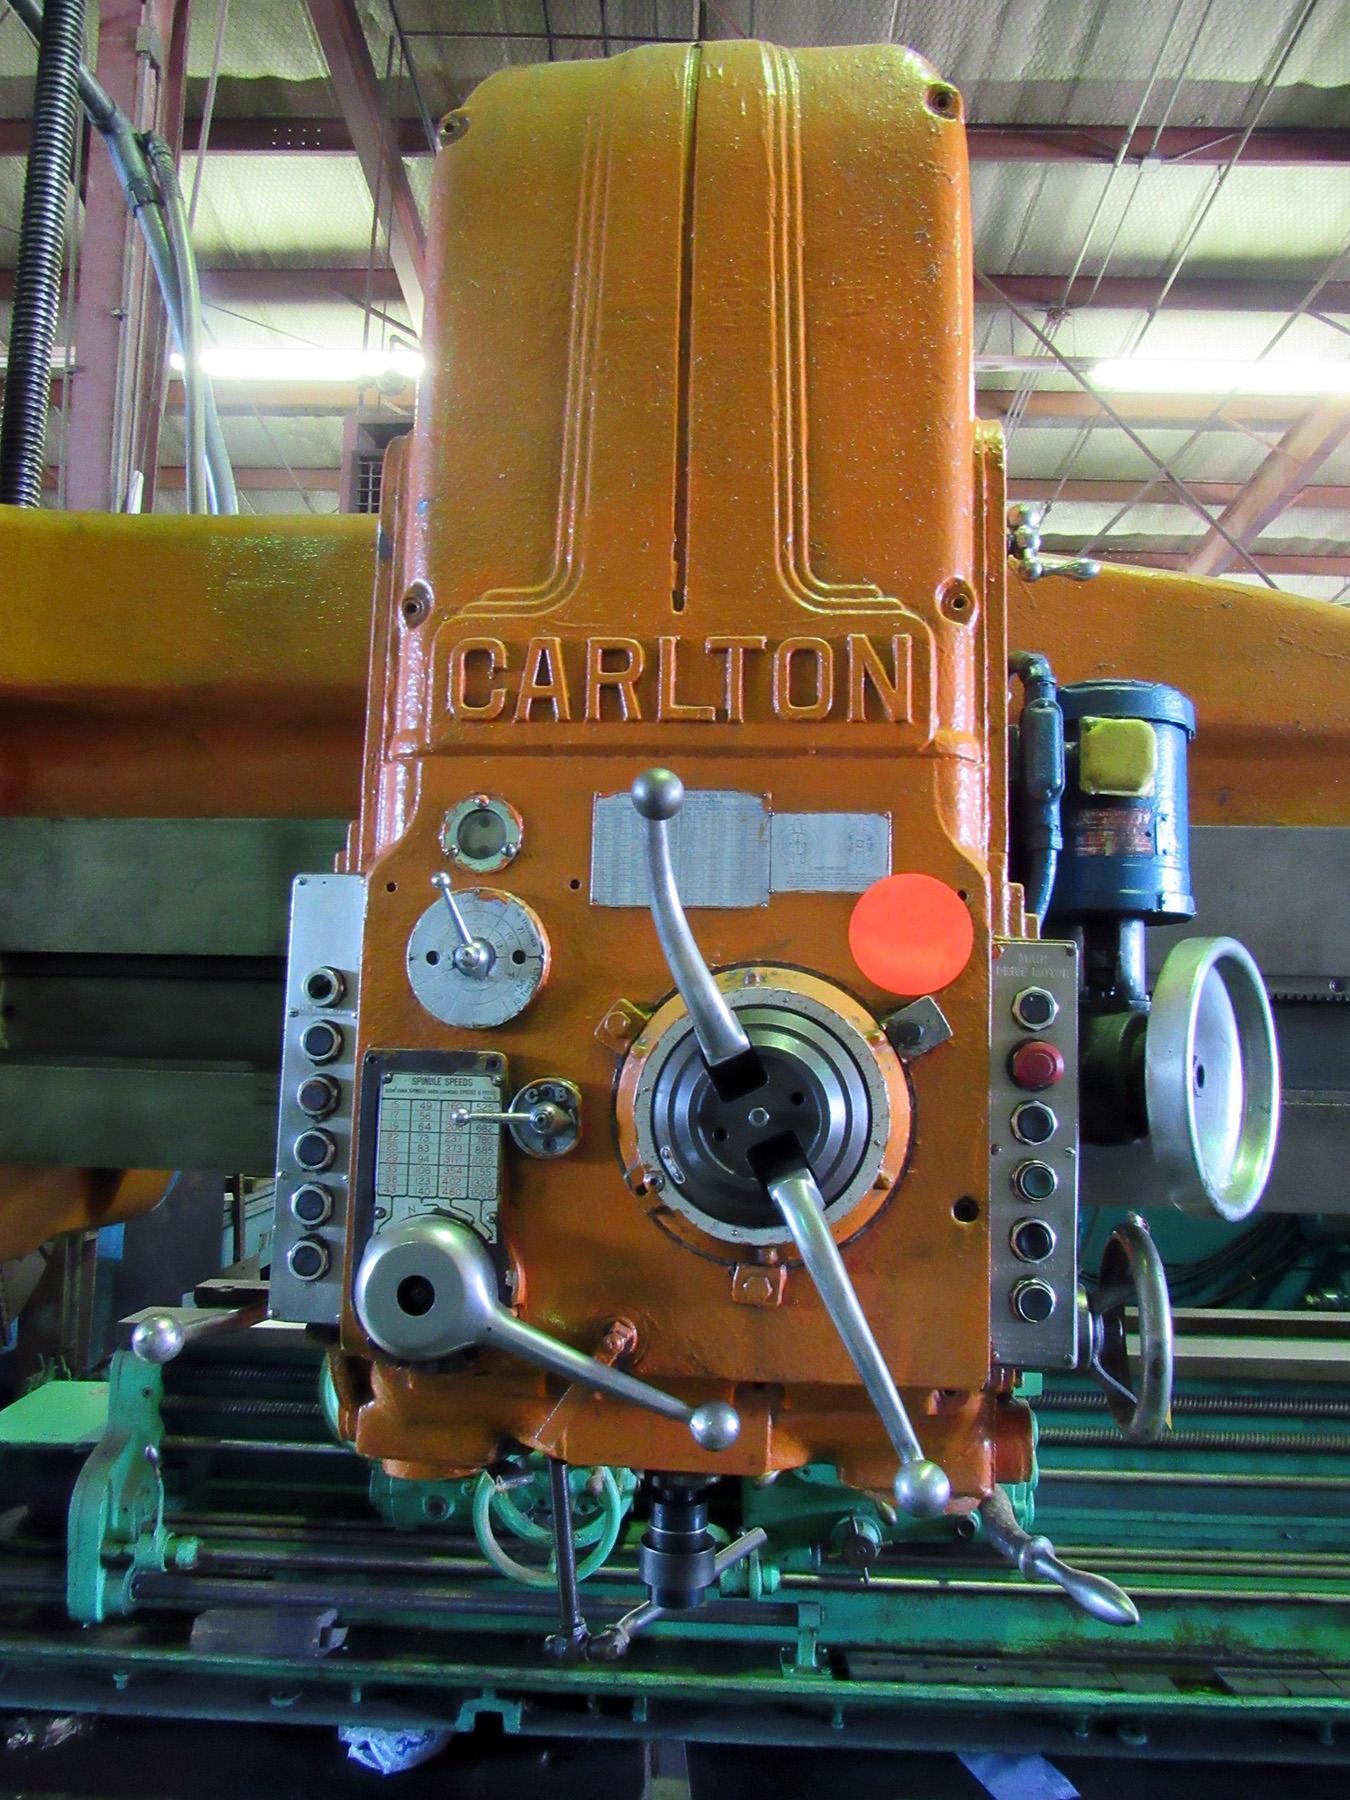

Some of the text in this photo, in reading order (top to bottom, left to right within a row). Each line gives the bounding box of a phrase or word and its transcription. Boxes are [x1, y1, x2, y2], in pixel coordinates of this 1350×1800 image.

[447, 633, 915, 724] CARLTON
[411, 1077, 473, 1087] SPINDLE SPEEDS
[524, 1086, 568, 1103] C B
[419, 1102, 433, 1110] 49
[476, 1103, 493, 1111] 525
[418, 1123, 432, 1131] 64
[418, 1134, 430, 1142] 73
[444, 1135, 463, 1143] 237
[477, 1136, 494, 1144] 780
[386, 1144, 399, 1152] 25
[417, 1144, 430, 1152] 83
[444, 1145, 463, 1153] 273
[417, 1155, 431, 1163] 94
[471, 1157, 494, 1166] 1005
[384, 1165, 398, 1173] 33
[415, 1166, 432, 1174] 108
[443, 1167, 462, 1175] 354
[471, 1168, 491, 1177] 1155
[384, 1175, 398, 1184] 38
[415, 1176, 431, 1185] 123
[442, 1177, 462, 1185] 402
[470, 1179, 493, 1188] 1320
[383, 1186, 397, 1194] 43
[414, 1187, 431, 1195] 140
[470, 1190, 493, 1199] 1500
[407, 1204, 417, 1214] N
